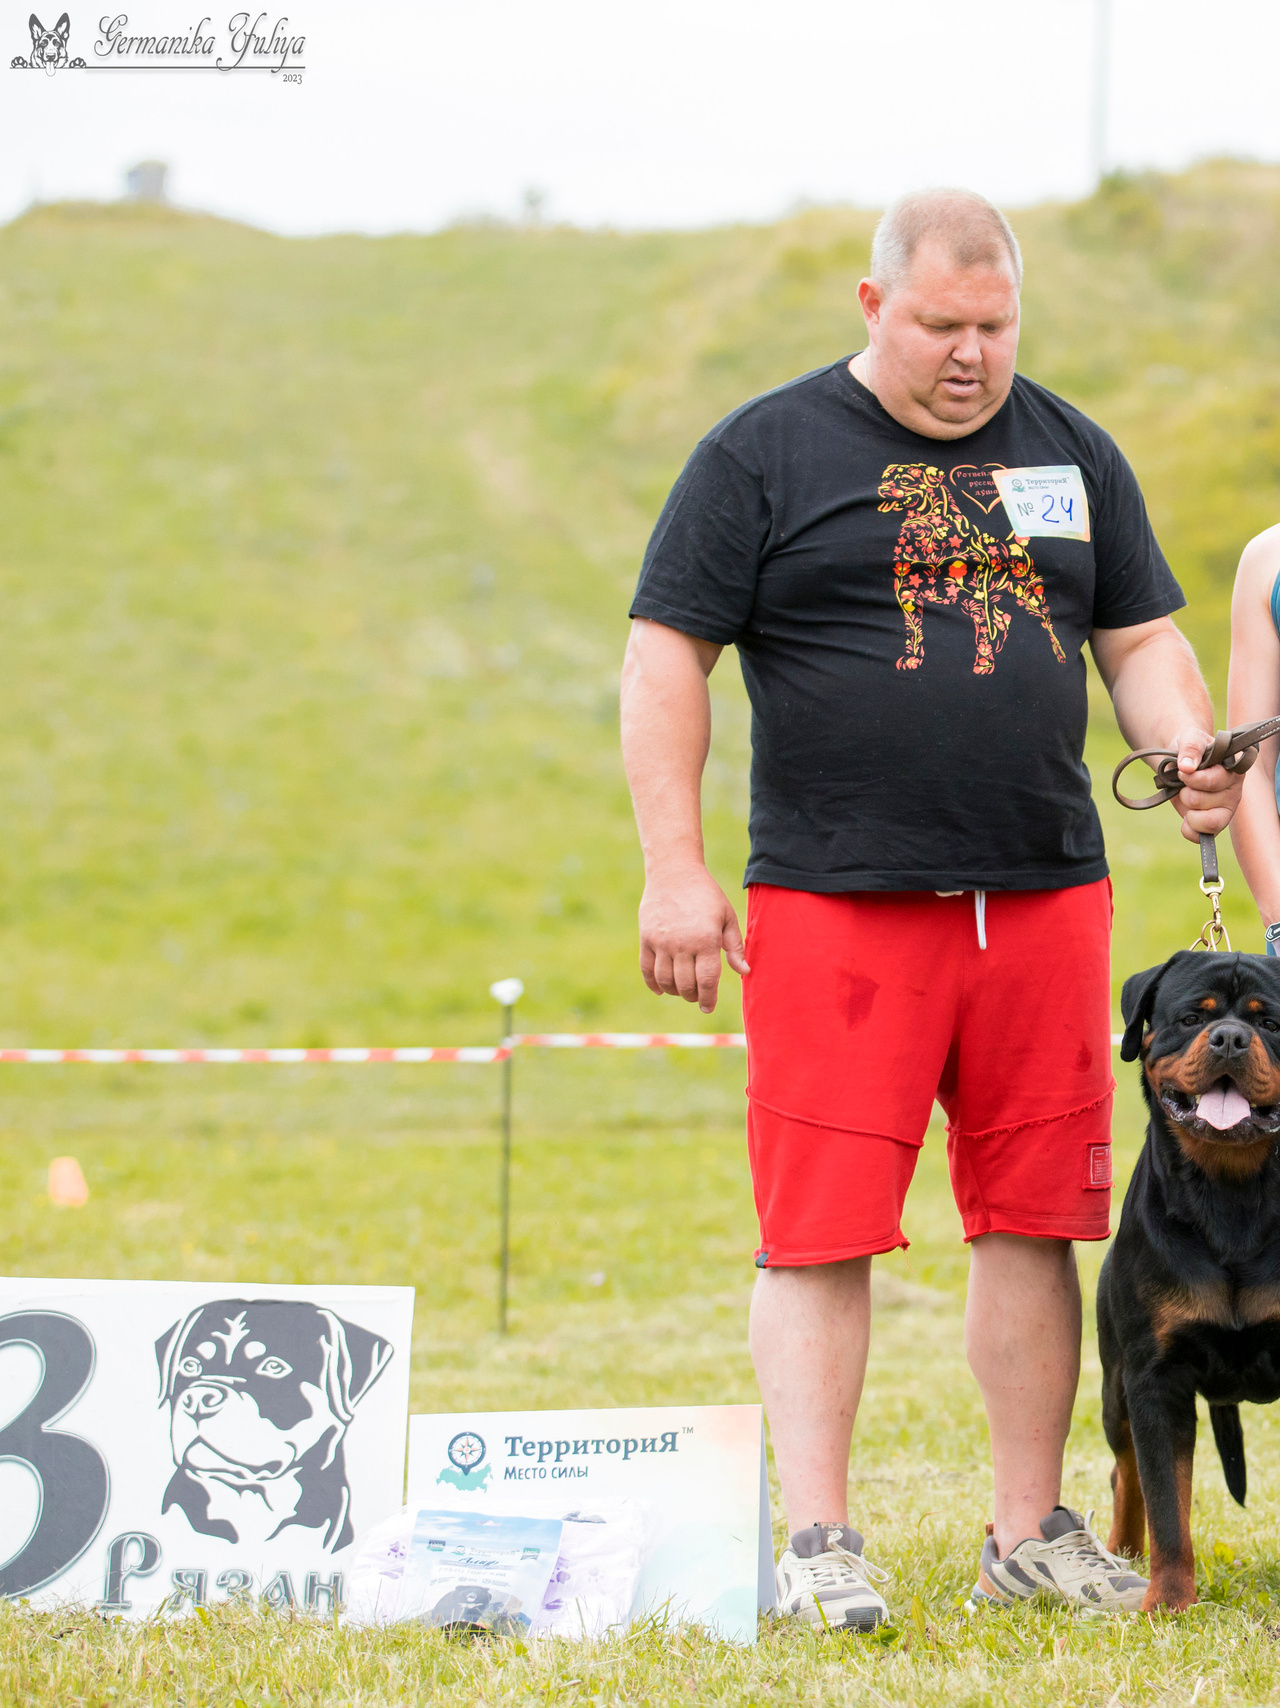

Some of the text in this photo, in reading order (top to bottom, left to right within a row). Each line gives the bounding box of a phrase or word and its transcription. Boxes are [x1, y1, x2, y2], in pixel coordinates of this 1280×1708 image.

[956, 470, 993, 478] Ротвейл
[1042, 494, 1073, 523] 24
[95, 1531, 346, 1612] Рязан
